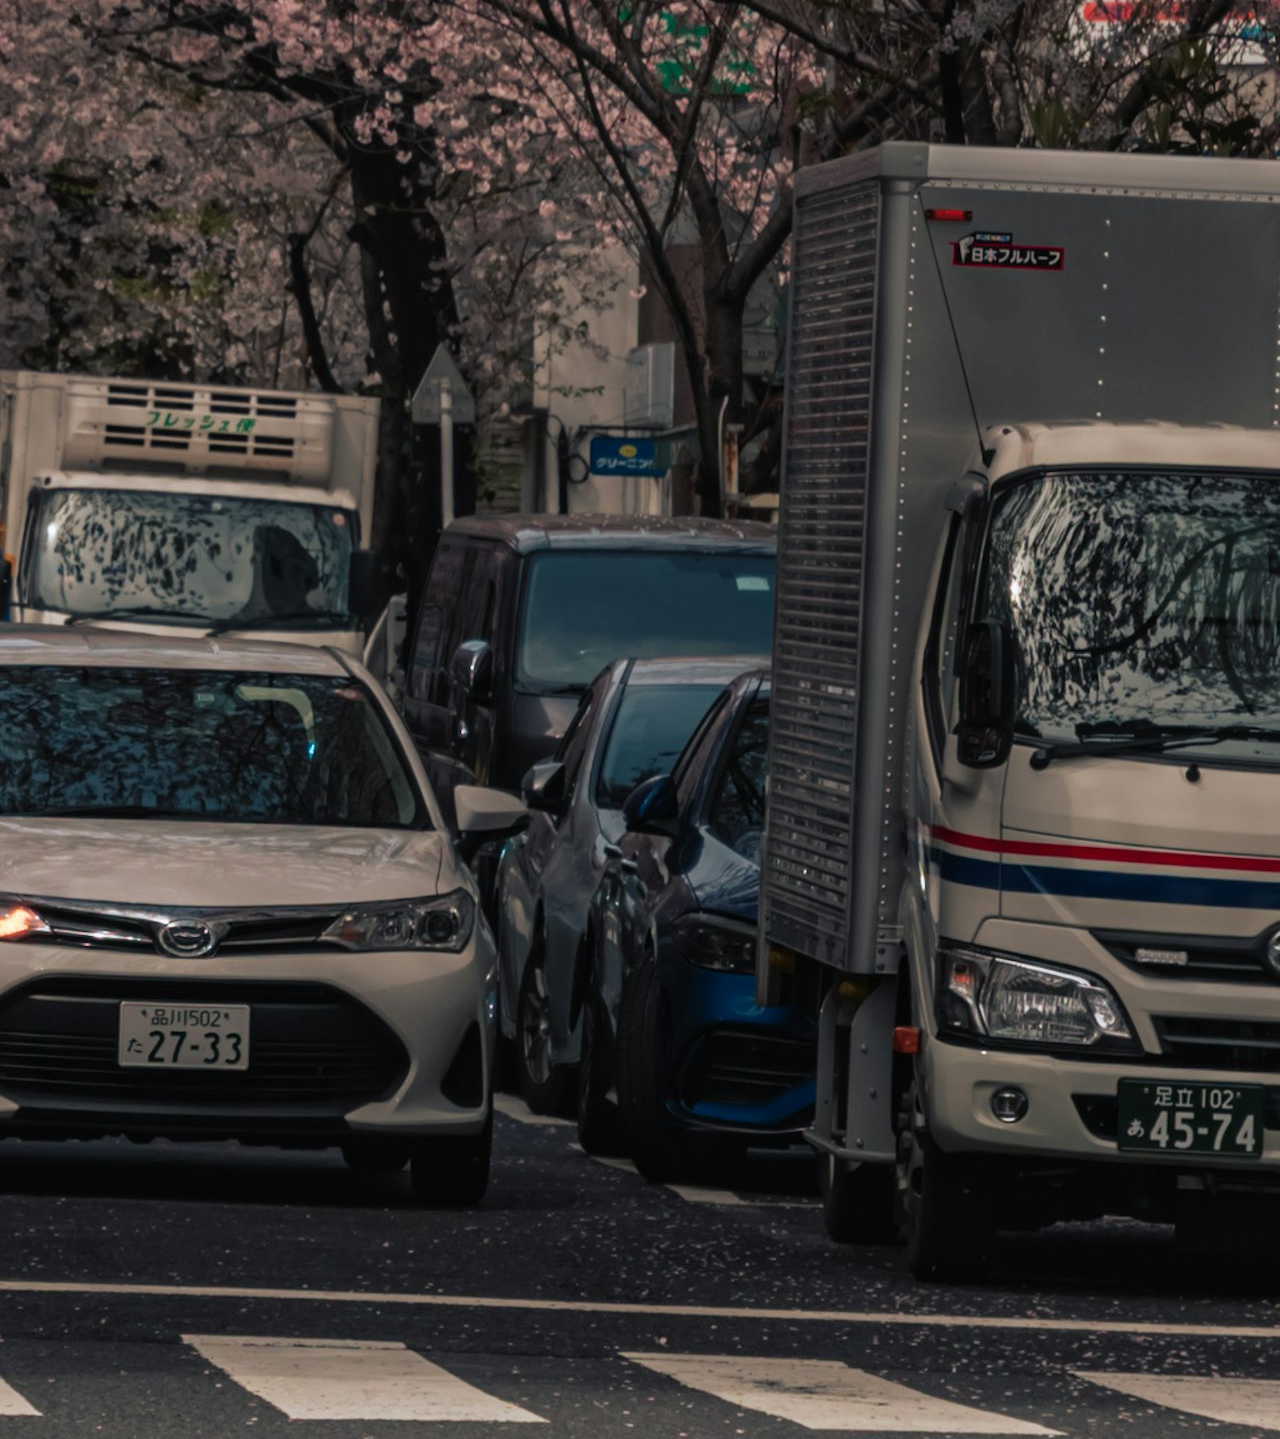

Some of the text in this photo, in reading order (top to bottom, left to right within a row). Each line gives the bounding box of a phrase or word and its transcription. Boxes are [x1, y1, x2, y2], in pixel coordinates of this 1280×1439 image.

[971, 247, 1061, 265] 日本フルハーフ
[147, 411, 256, 432] フレッシュ便
[596, 458, 653, 470] クリーニン
[127, 1030, 241, 1064] た 27-33
[1127, 1110, 1256, 1152] あ 45-74
